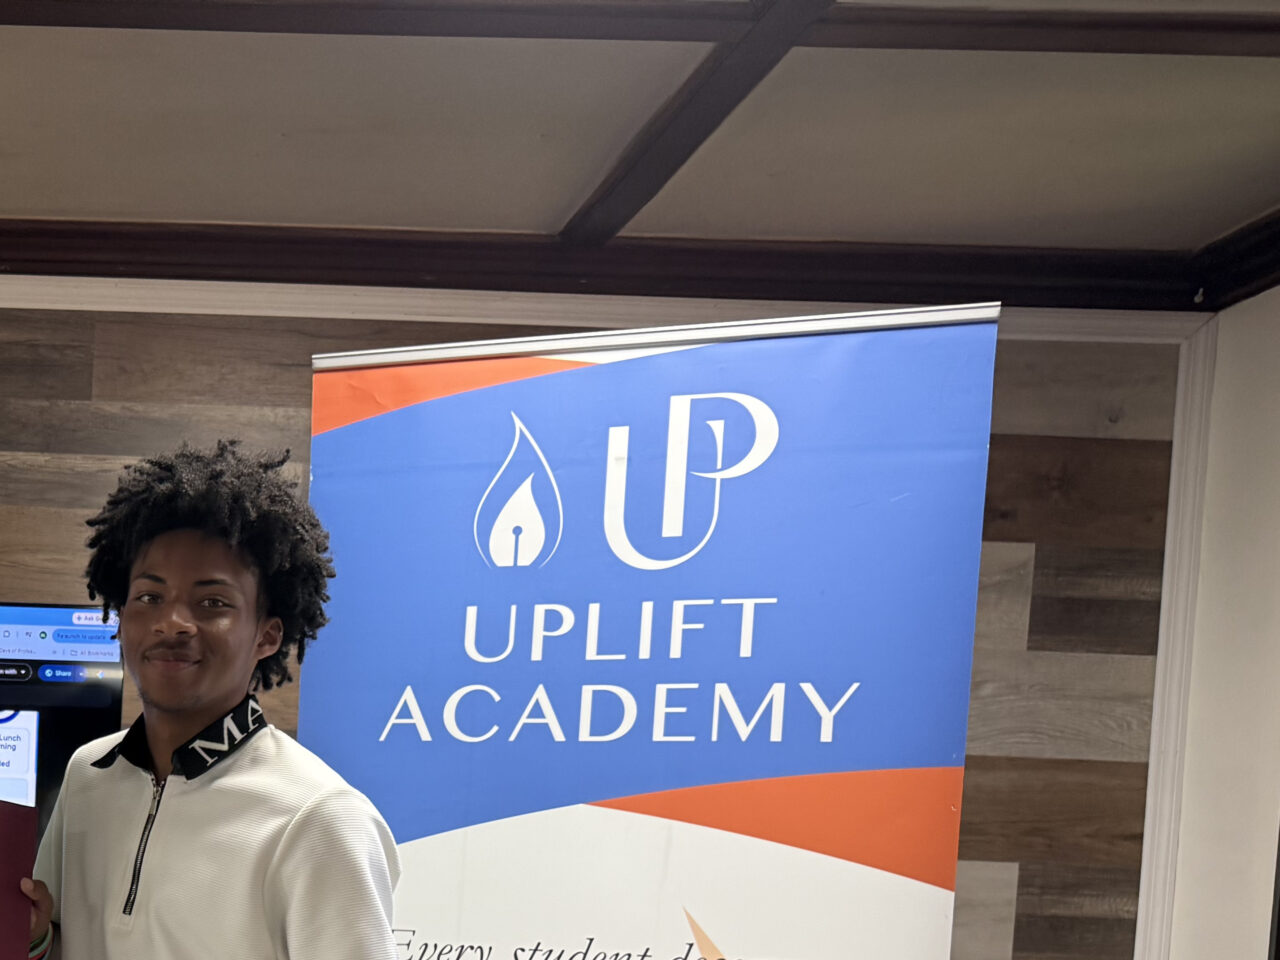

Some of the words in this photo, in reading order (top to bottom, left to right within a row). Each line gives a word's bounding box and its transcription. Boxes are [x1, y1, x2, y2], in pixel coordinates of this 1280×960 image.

[463, 597, 778, 664] UPLIFT
[55, 669, 72, 677] Share
[378, 682, 861, 743] ACADEMY
